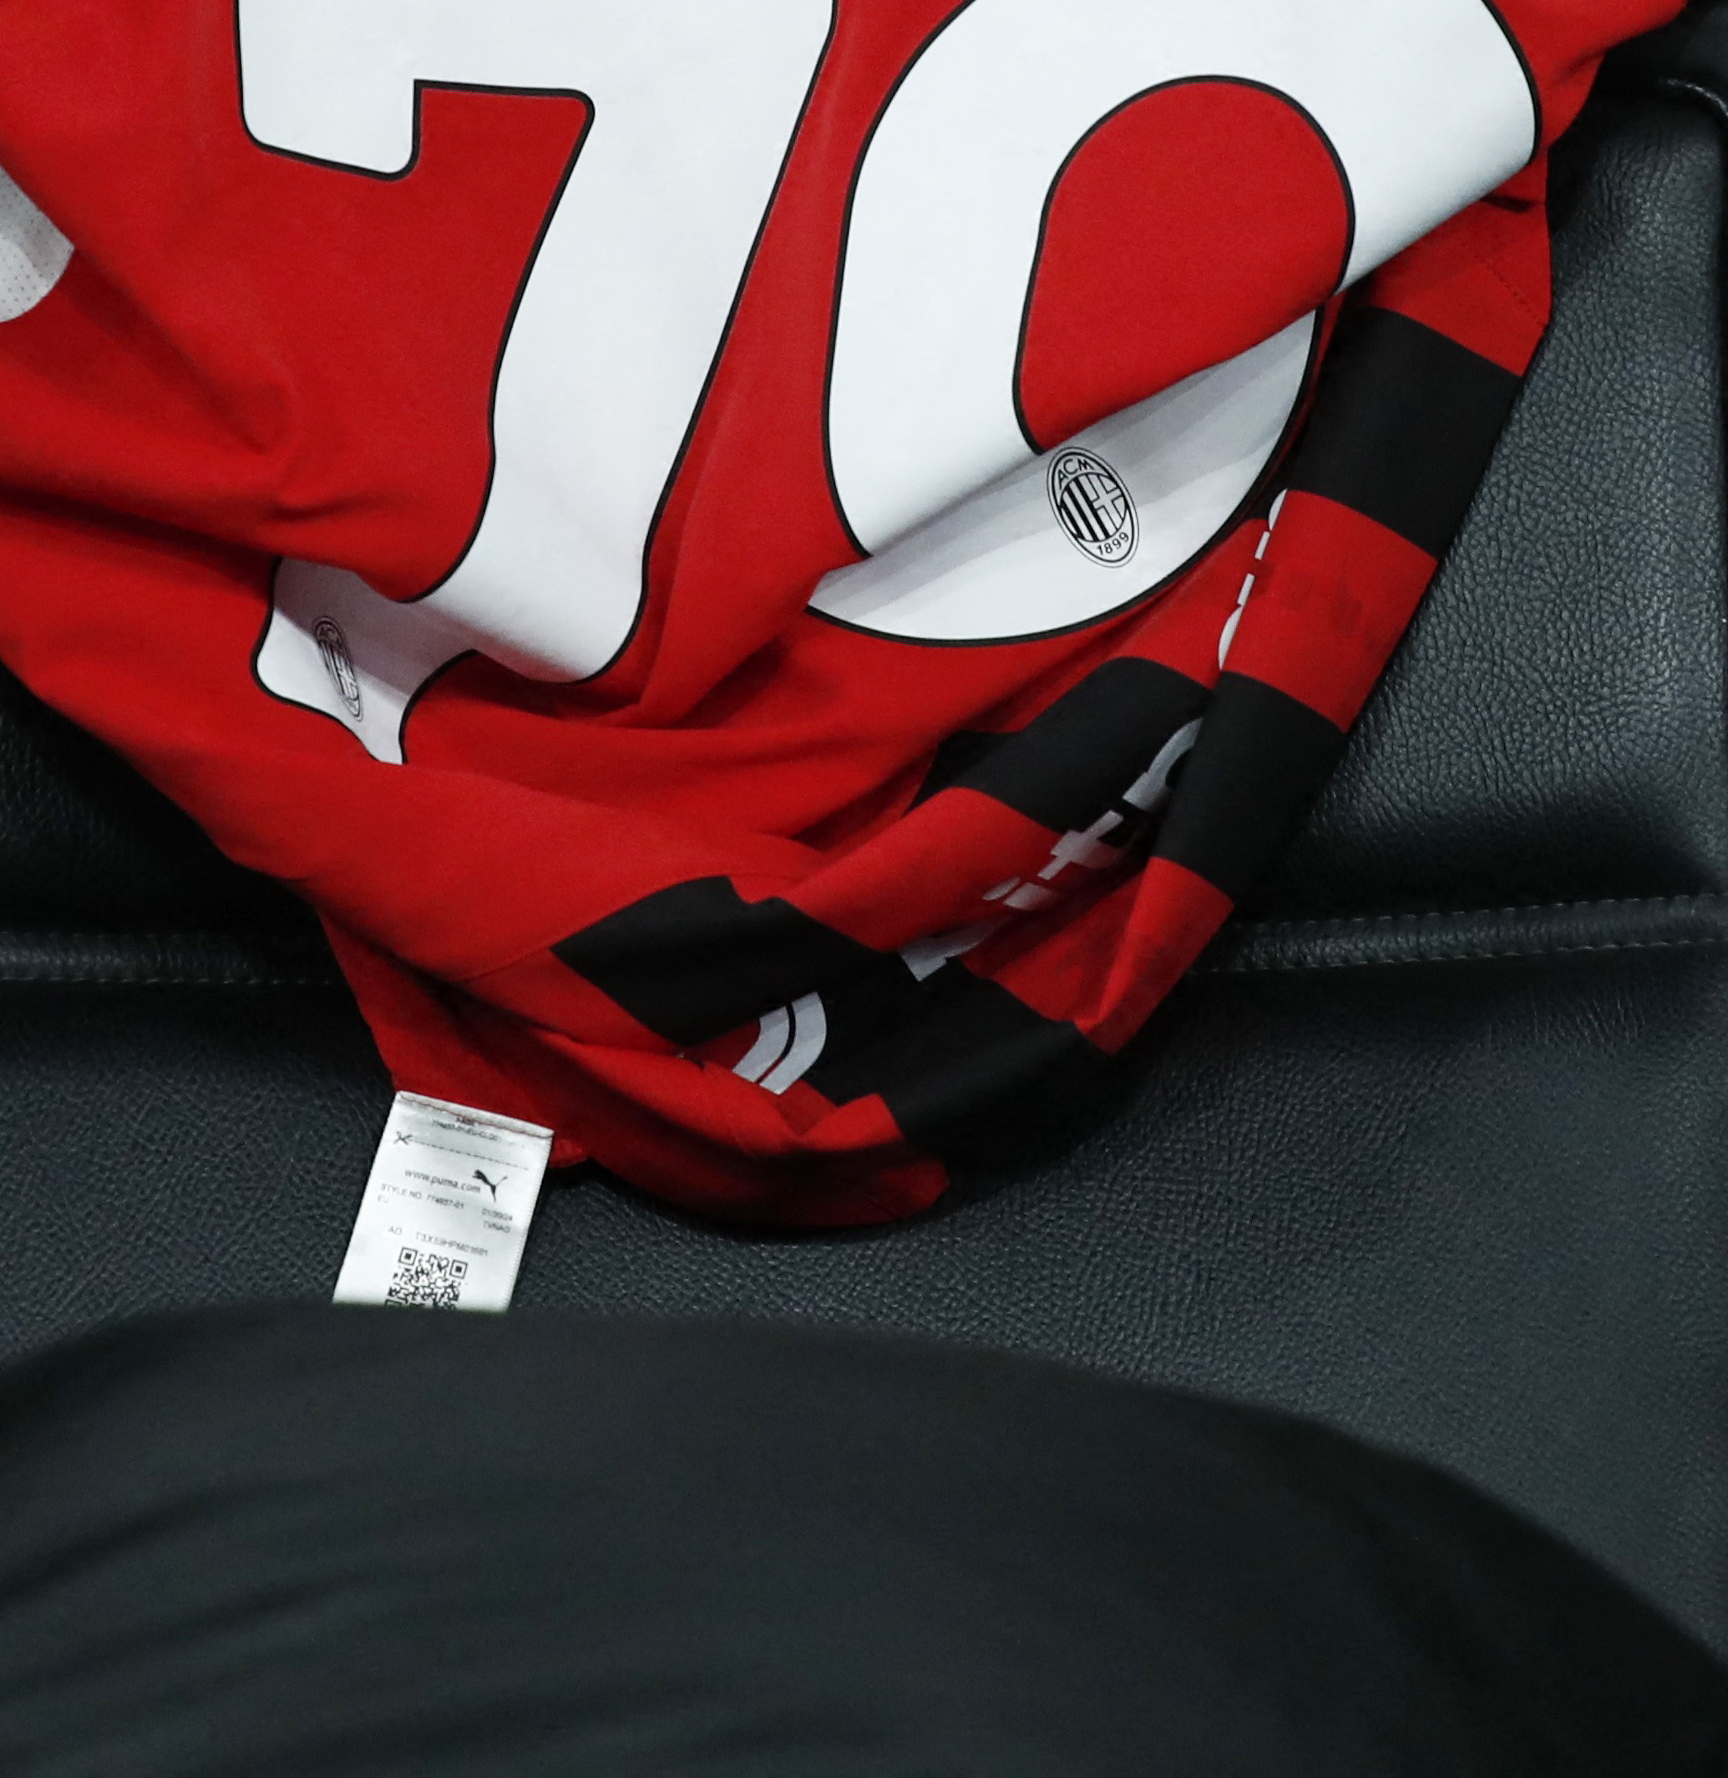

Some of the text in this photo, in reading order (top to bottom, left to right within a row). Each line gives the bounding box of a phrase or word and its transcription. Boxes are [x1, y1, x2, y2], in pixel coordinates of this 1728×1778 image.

[1058, 458, 1095, 490] ACM
[1097, 531, 1130, 556] 1899
[404, 1169, 481, 1194] www.puma.com
